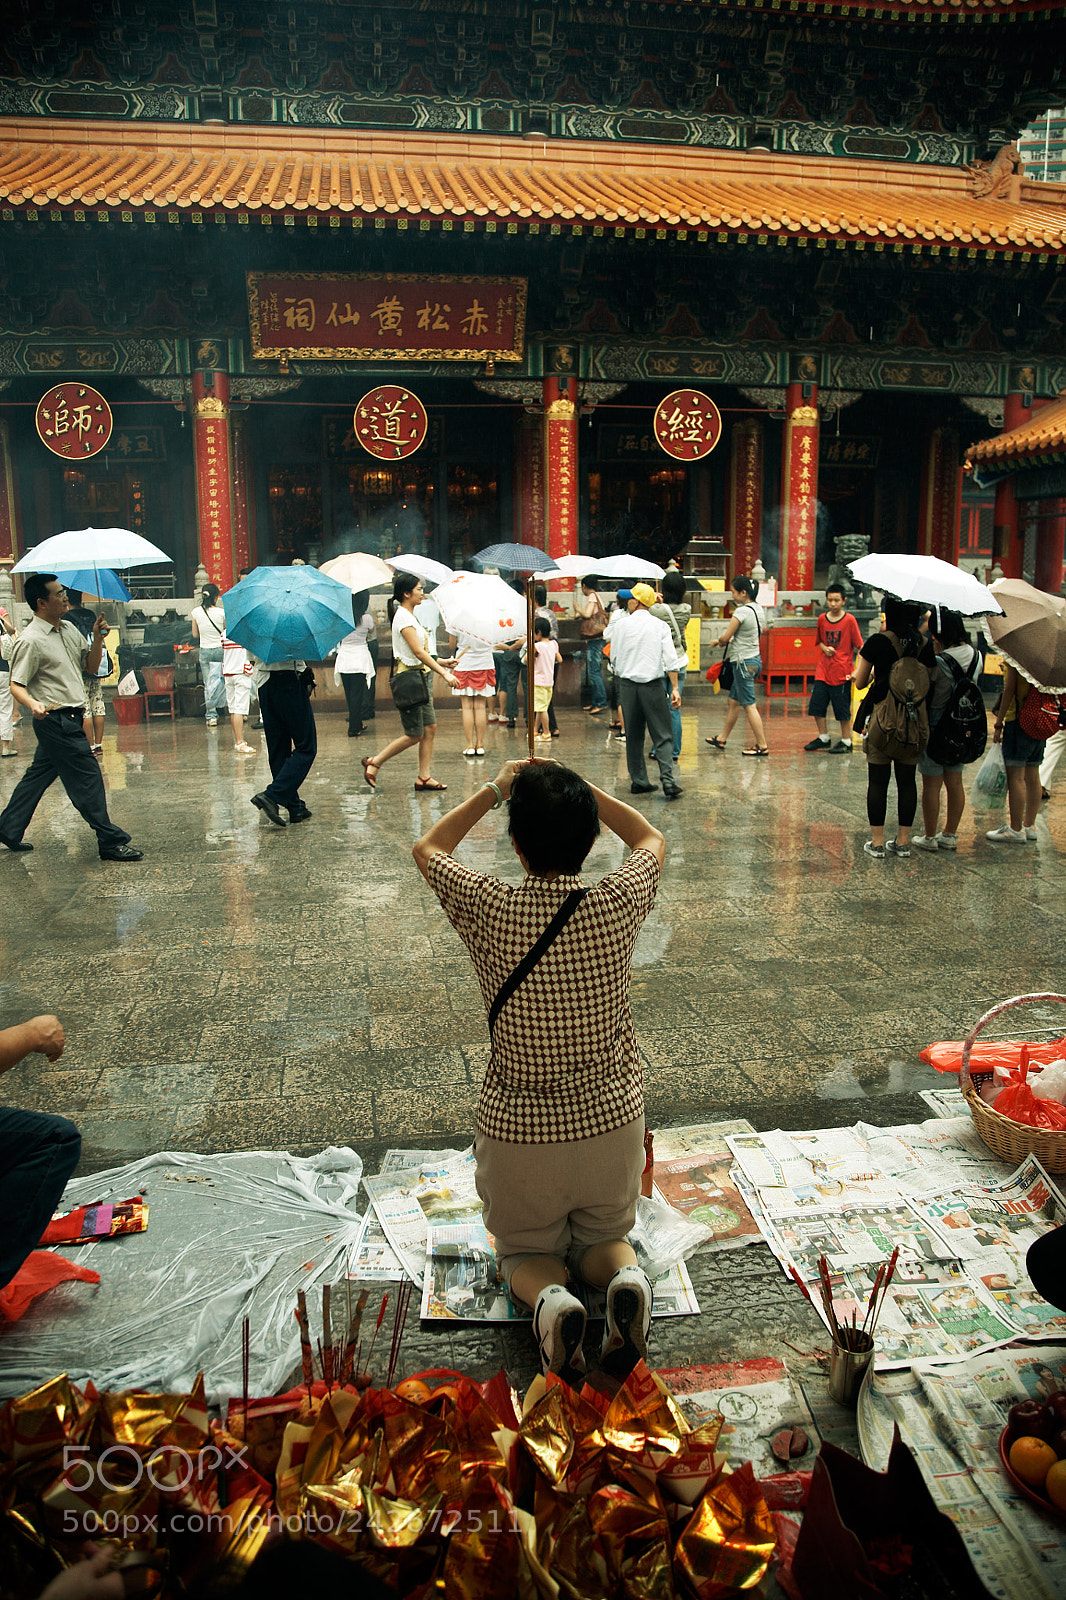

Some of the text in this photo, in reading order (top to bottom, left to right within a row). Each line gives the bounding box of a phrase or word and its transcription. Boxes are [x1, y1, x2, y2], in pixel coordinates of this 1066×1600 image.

[53, 399, 92, 442] 師
[369, 400, 410, 446] 道
[668, 408, 704, 443] 經
